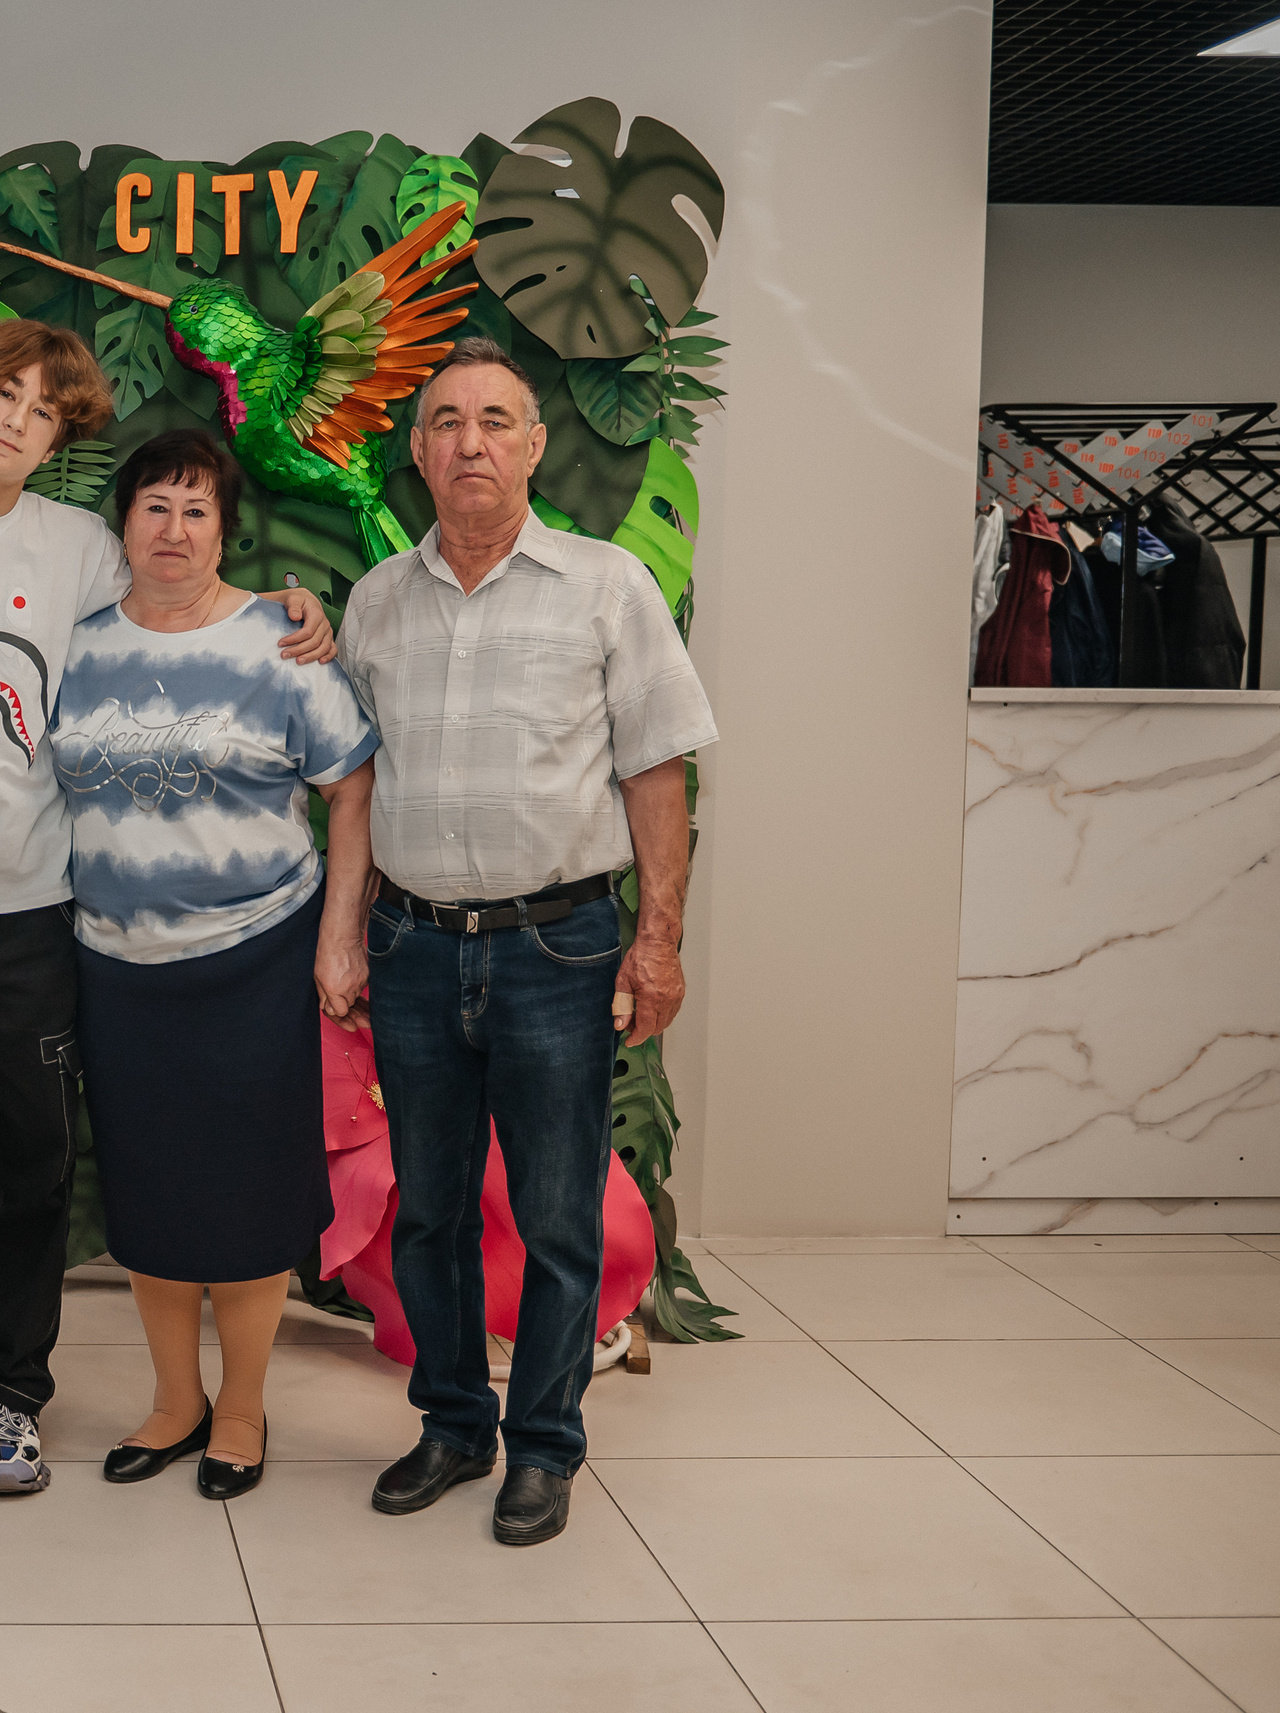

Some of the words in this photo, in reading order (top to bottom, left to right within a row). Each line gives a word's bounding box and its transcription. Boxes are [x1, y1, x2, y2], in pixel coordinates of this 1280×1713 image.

[116, 169, 319, 255] CITY
[1192, 414, 1213, 427] 101
[1167, 431, 1191, 446] 102
[1143, 449, 1166, 464] 103
[1117, 466, 1141, 480] 104
